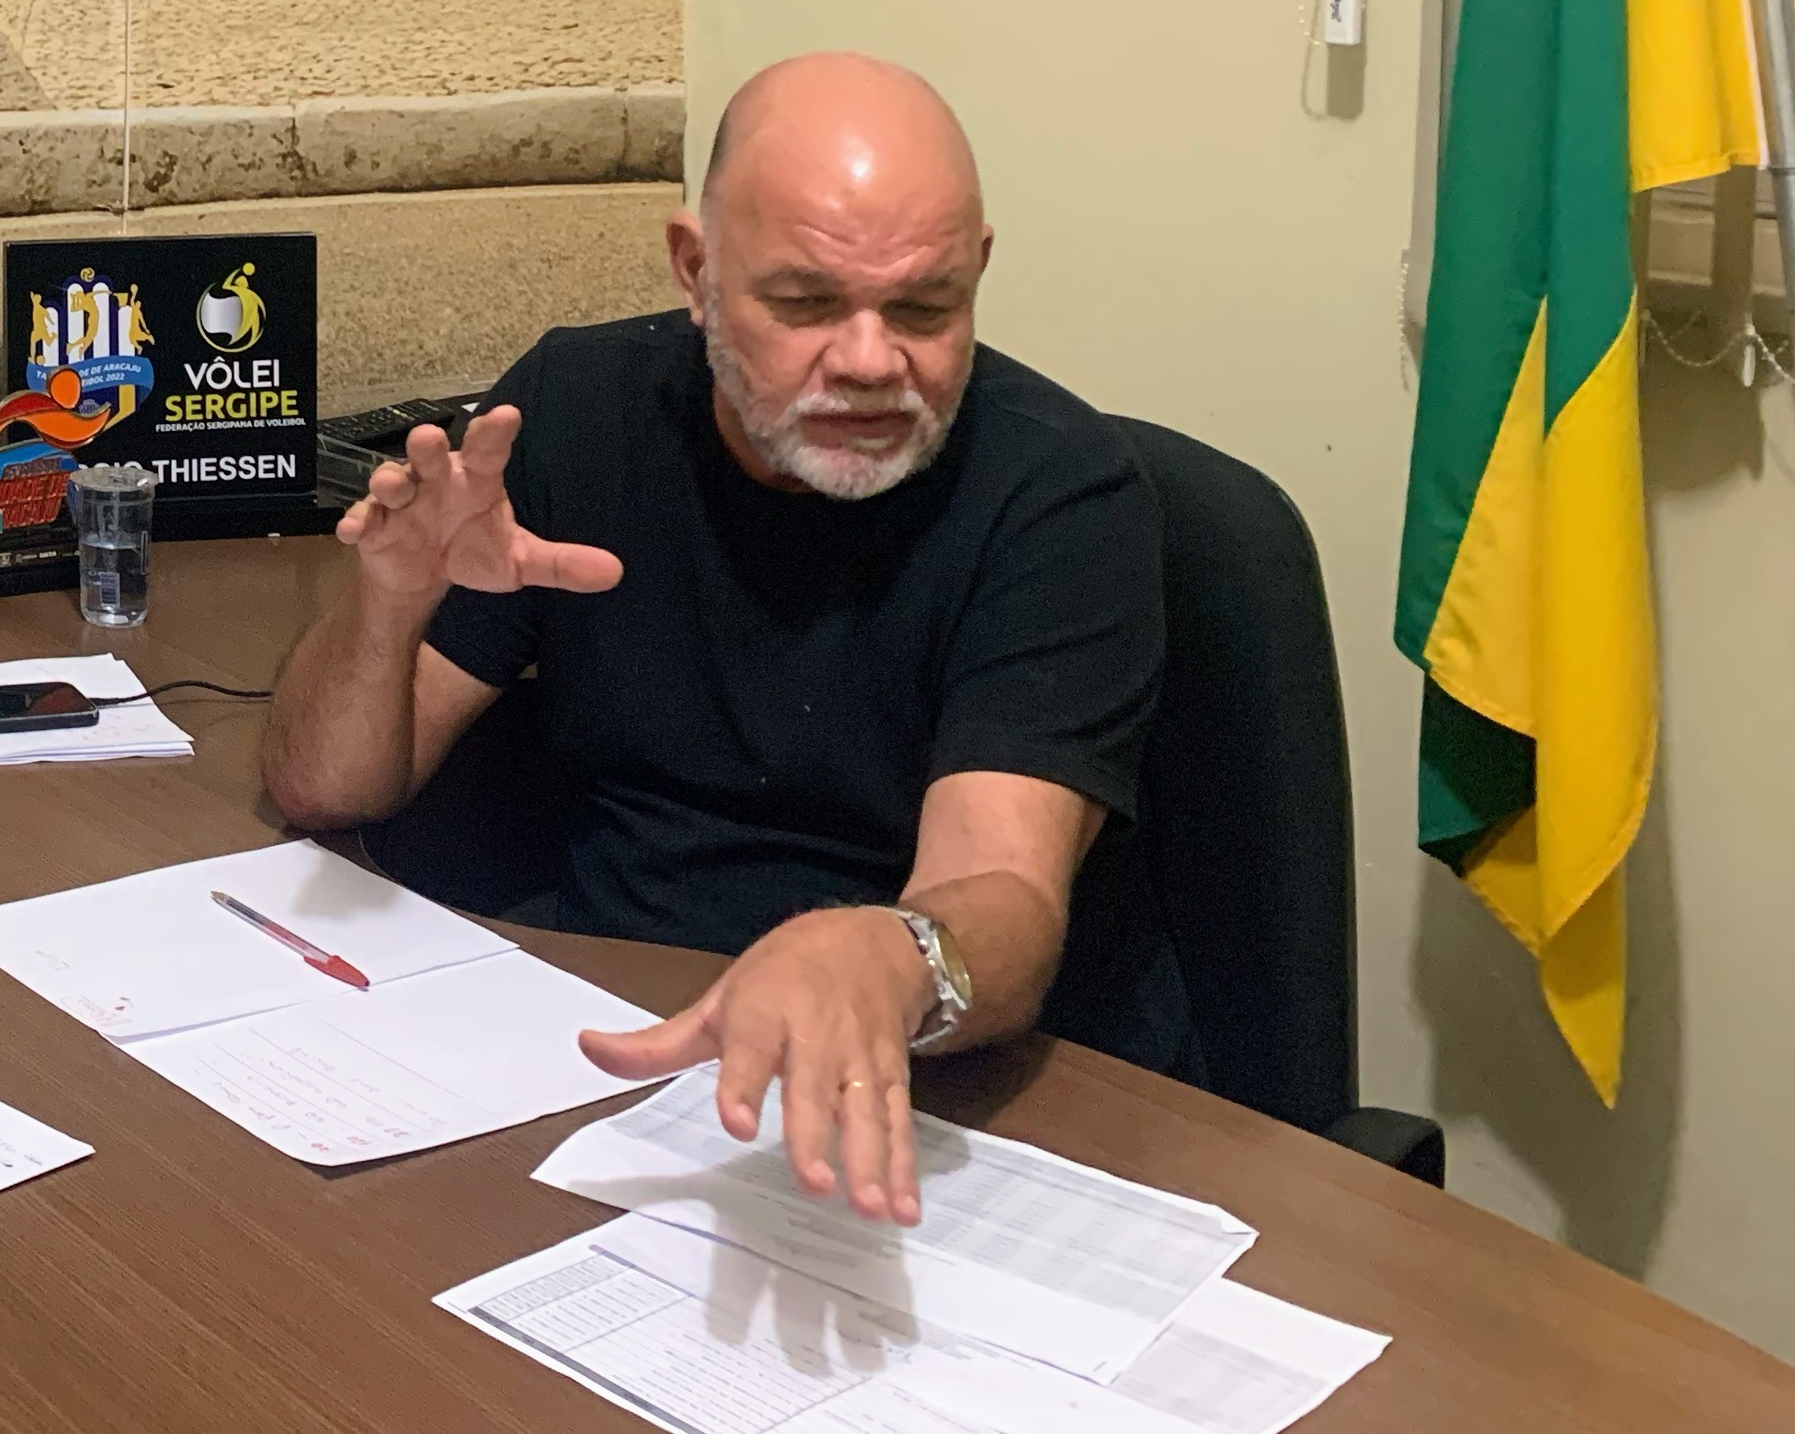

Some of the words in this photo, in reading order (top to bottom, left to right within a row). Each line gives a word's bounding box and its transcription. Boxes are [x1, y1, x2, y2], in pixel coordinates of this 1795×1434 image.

[91, 365, 101, 375] DE
[103, 362, 141, 373] ARACAJU
[105, 372, 125, 382] 2022
[184, 356, 279, 391] VÔLEI
[165, 390, 299, 422] SERGIPE
[156, 422, 205, 433] FEDERAÇÃO
[207, 419, 253, 430] SERGIPANA
[254, 419, 265, 428] DE
[266, 418, 306, 427] VOLEIBOL
[151, 454, 296, 483] THIESSEN
